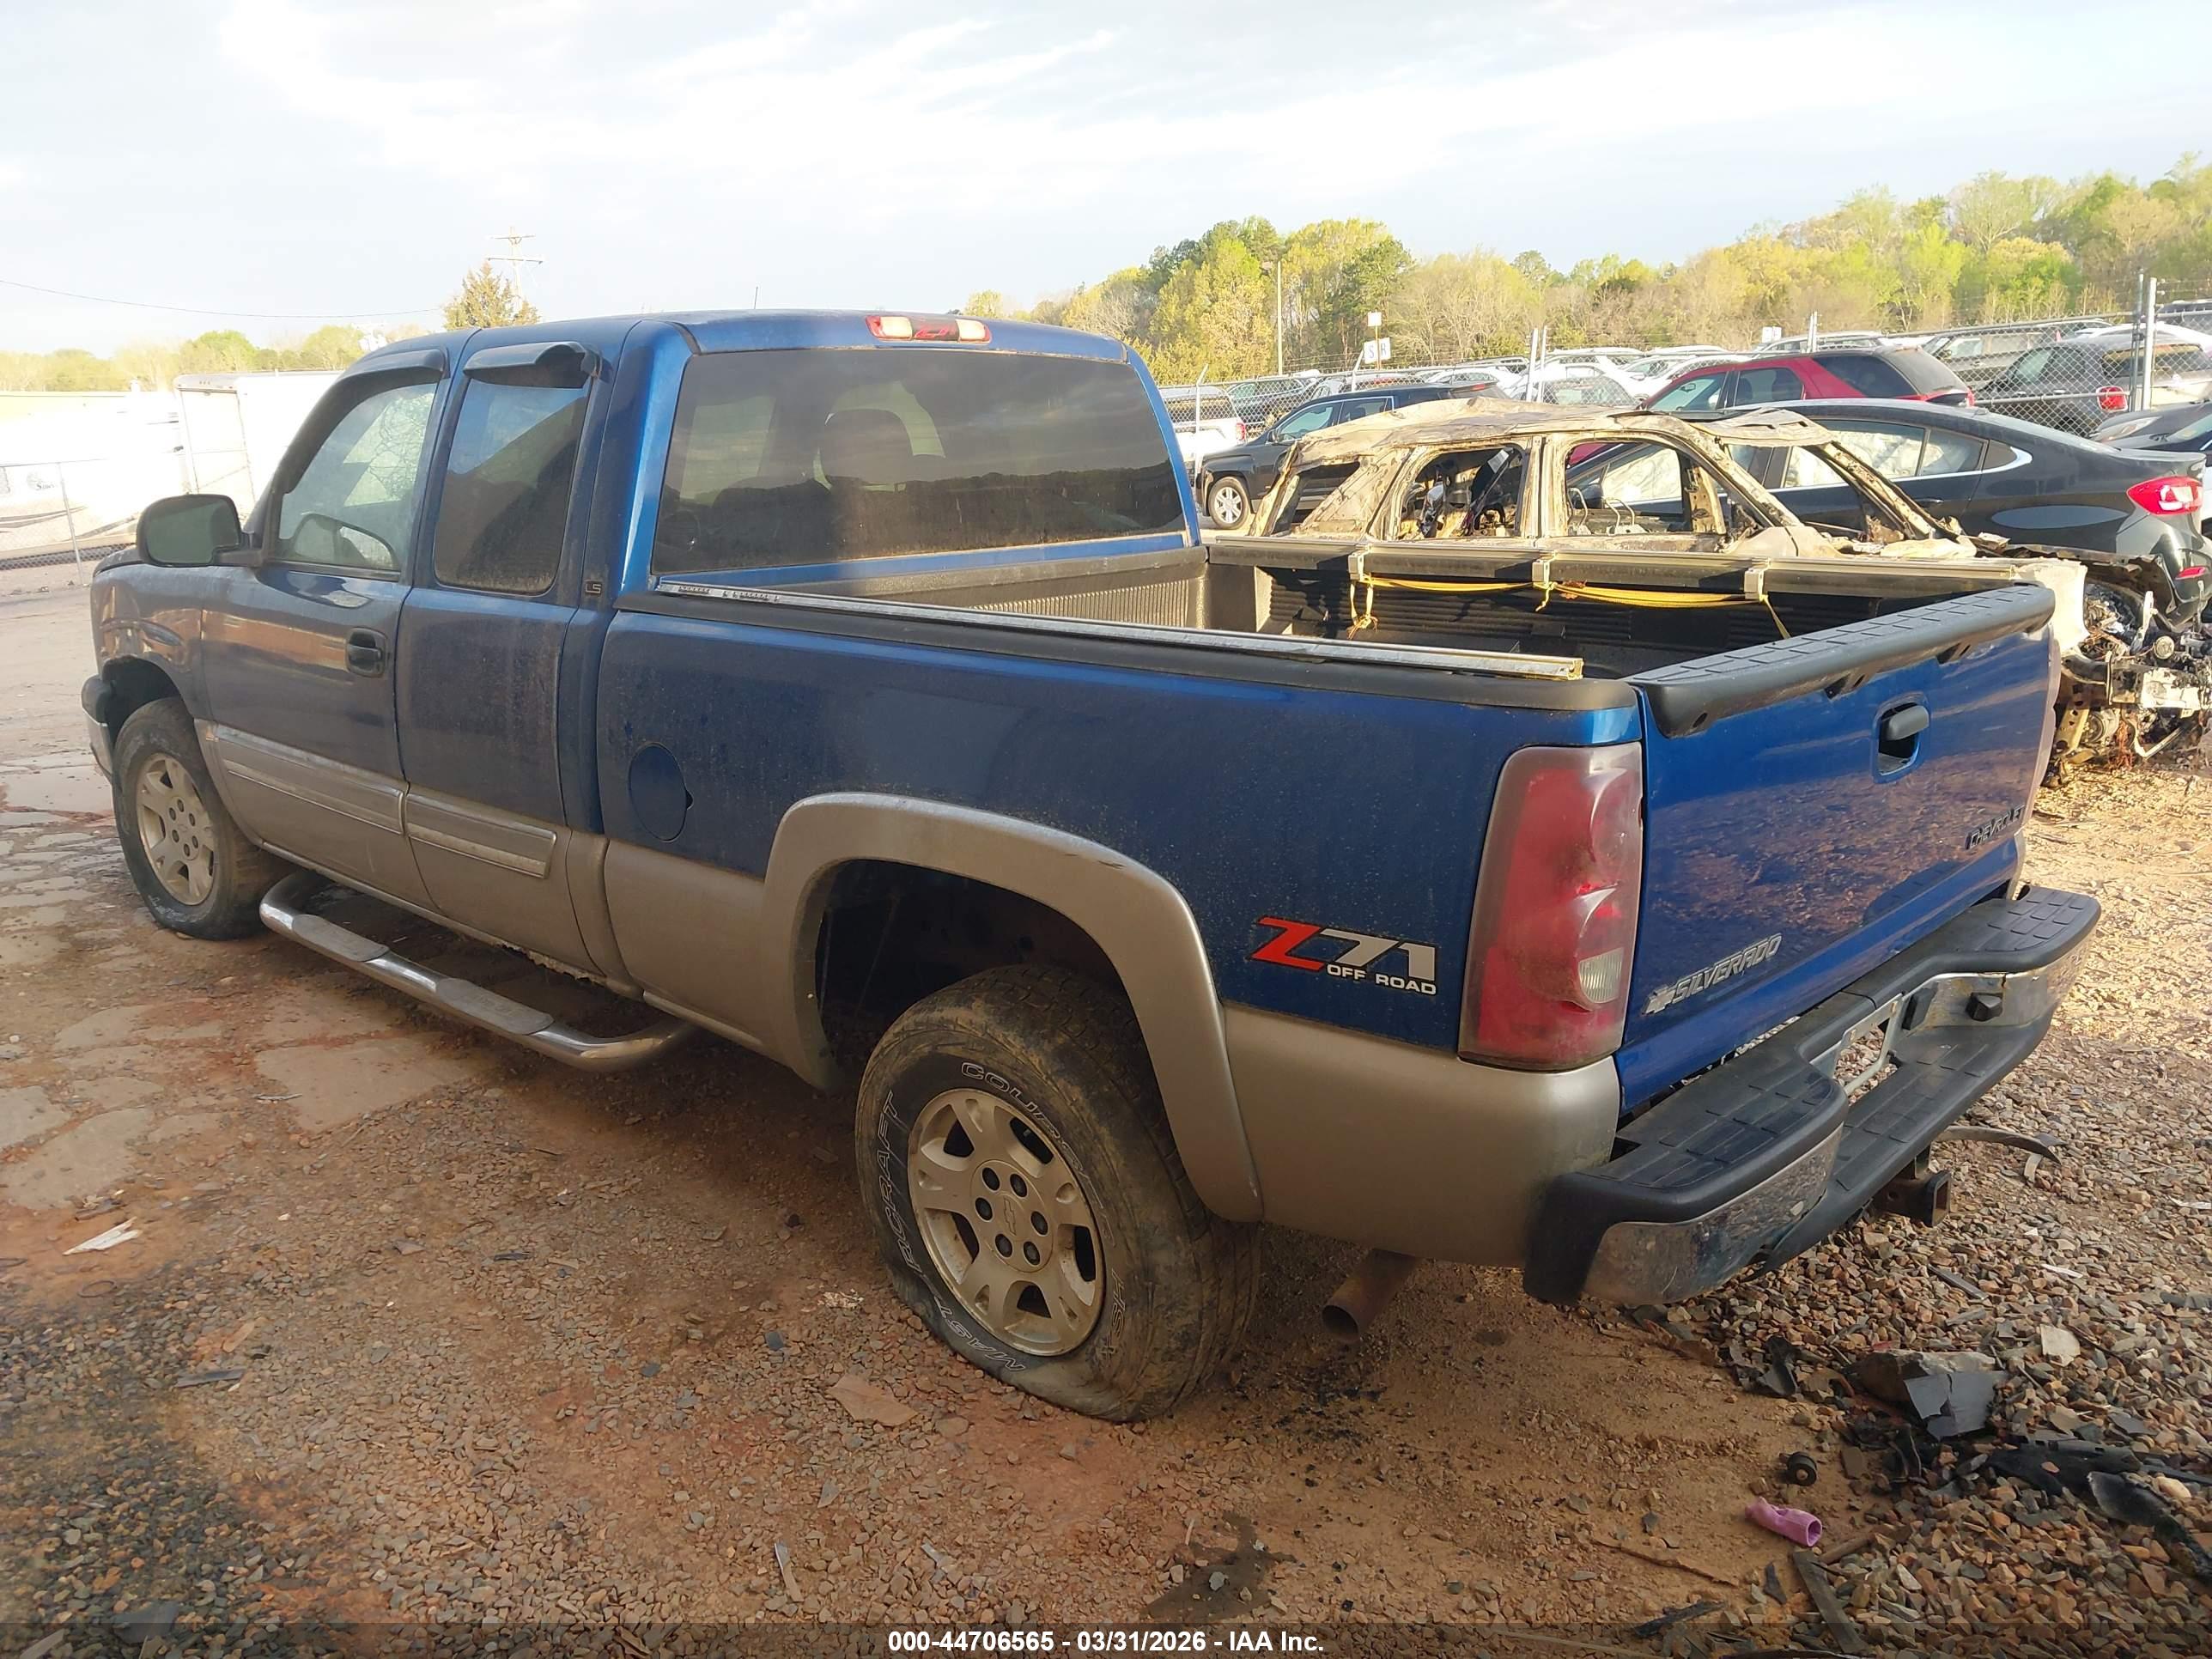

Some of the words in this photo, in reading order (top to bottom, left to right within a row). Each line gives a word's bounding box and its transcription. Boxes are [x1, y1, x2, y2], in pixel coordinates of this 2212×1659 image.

[585, 583, 602, 594] LS
[1251, 915, 1436, 981] Z71
[1672, 933, 1783, 1004] SILVERADO
[1327, 964, 1366, 980] OFF
[1376, 973, 1437, 995] ROAD
